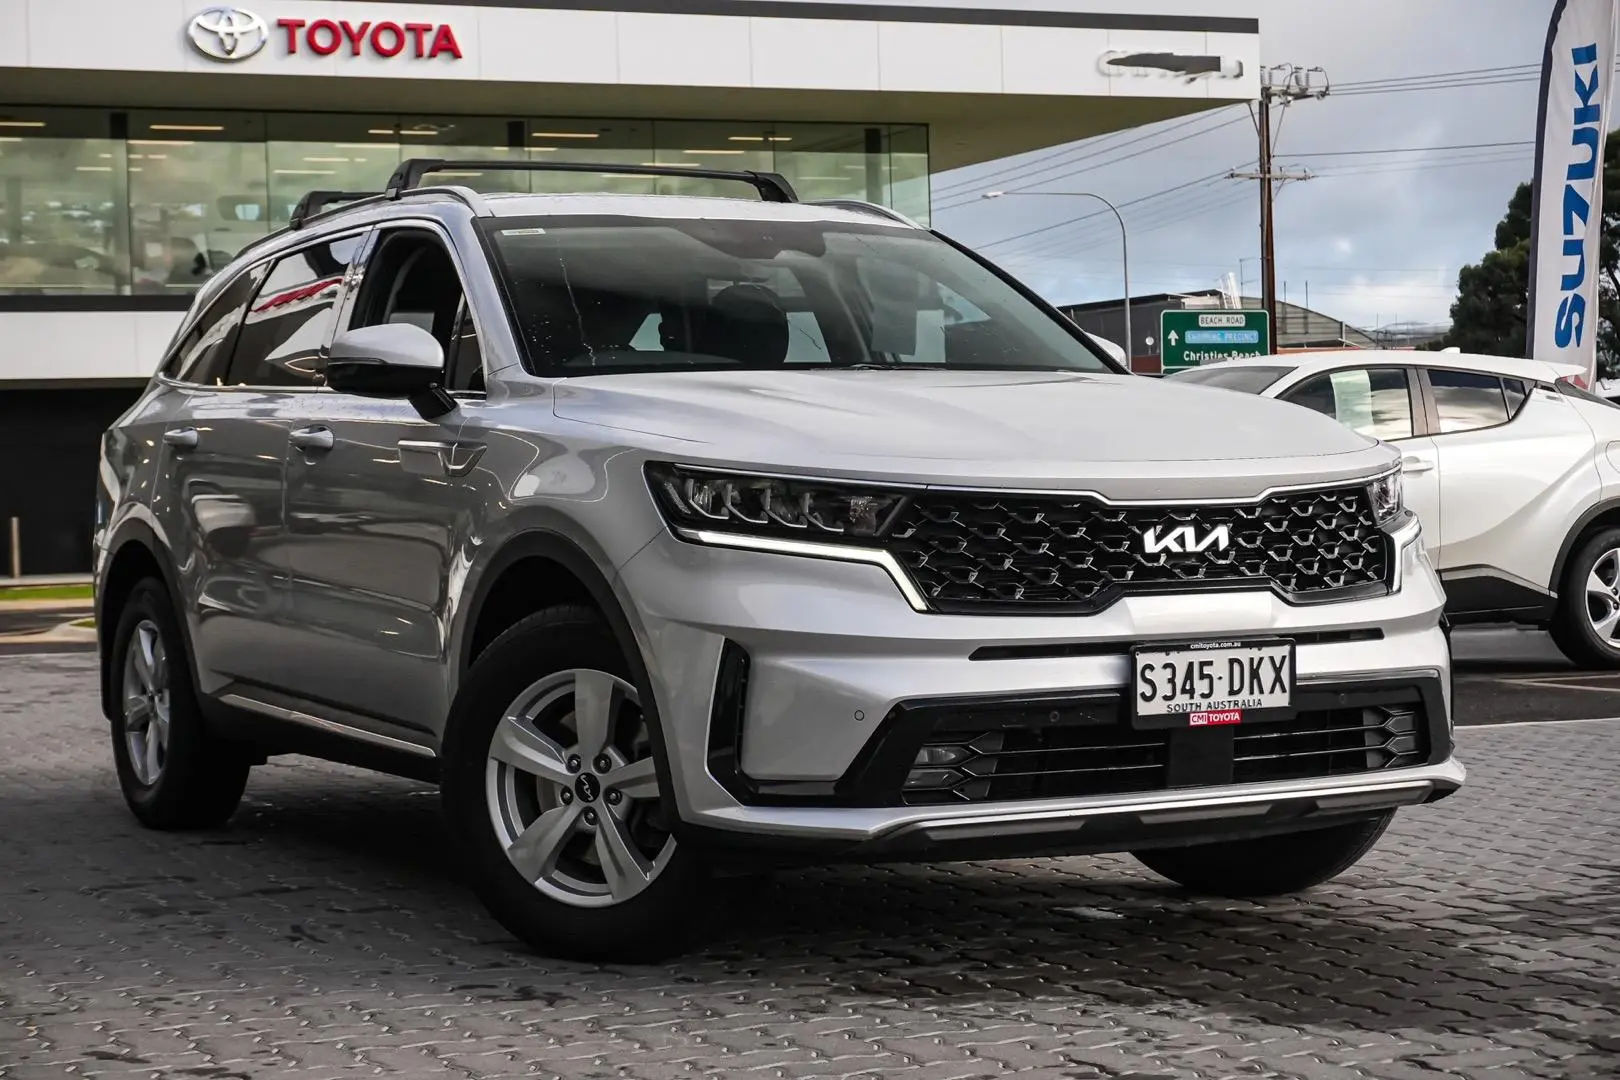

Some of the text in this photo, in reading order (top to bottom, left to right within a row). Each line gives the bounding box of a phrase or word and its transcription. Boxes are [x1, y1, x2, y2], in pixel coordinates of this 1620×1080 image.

[277, 18, 463, 59] TOYOTA
[1554, 42, 1601, 348] SUZUKI
[1200, 316, 1244, 325] BEACH ROAD
[1183, 350, 1229, 361] Christies
[1143, 526, 1229, 553] KIA
[1190, 641, 1242, 650] cmitoyota.com.au
[1167, 698, 1263, 713] SOUTH AUSTRALIA
[1208, 712, 1241, 722] TOYOTA
